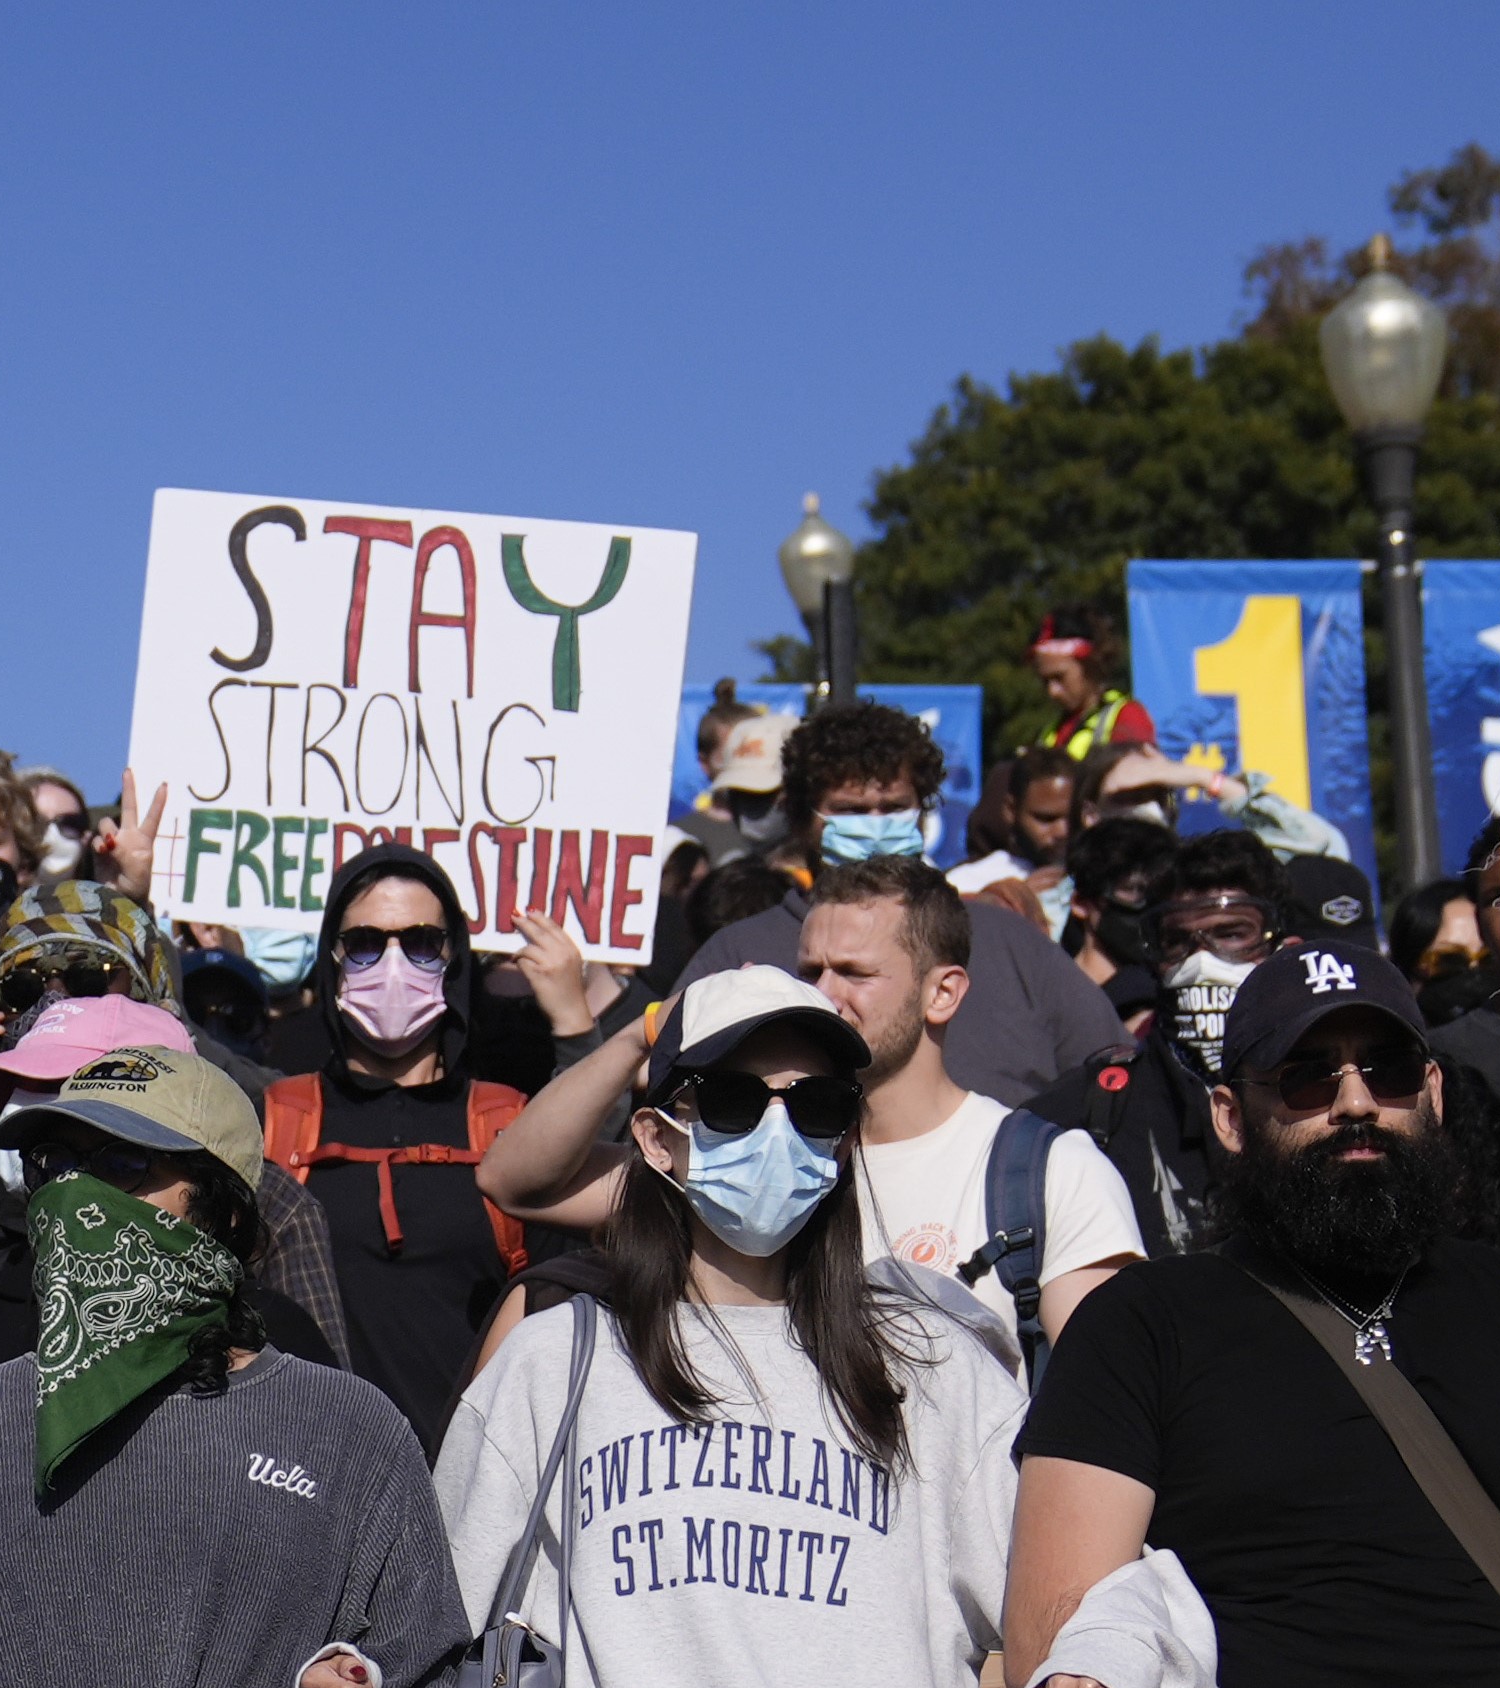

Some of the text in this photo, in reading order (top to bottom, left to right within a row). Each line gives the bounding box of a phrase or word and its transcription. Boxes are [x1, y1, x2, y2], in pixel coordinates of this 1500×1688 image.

[209, 504, 632, 712] STAY
[188, 679, 556, 826] STRONG
[1298, 950, 1357, 994] LA
[248, 1452, 318, 1500] Ucla
[578, 1421, 890, 1537] SWITZERLAND
